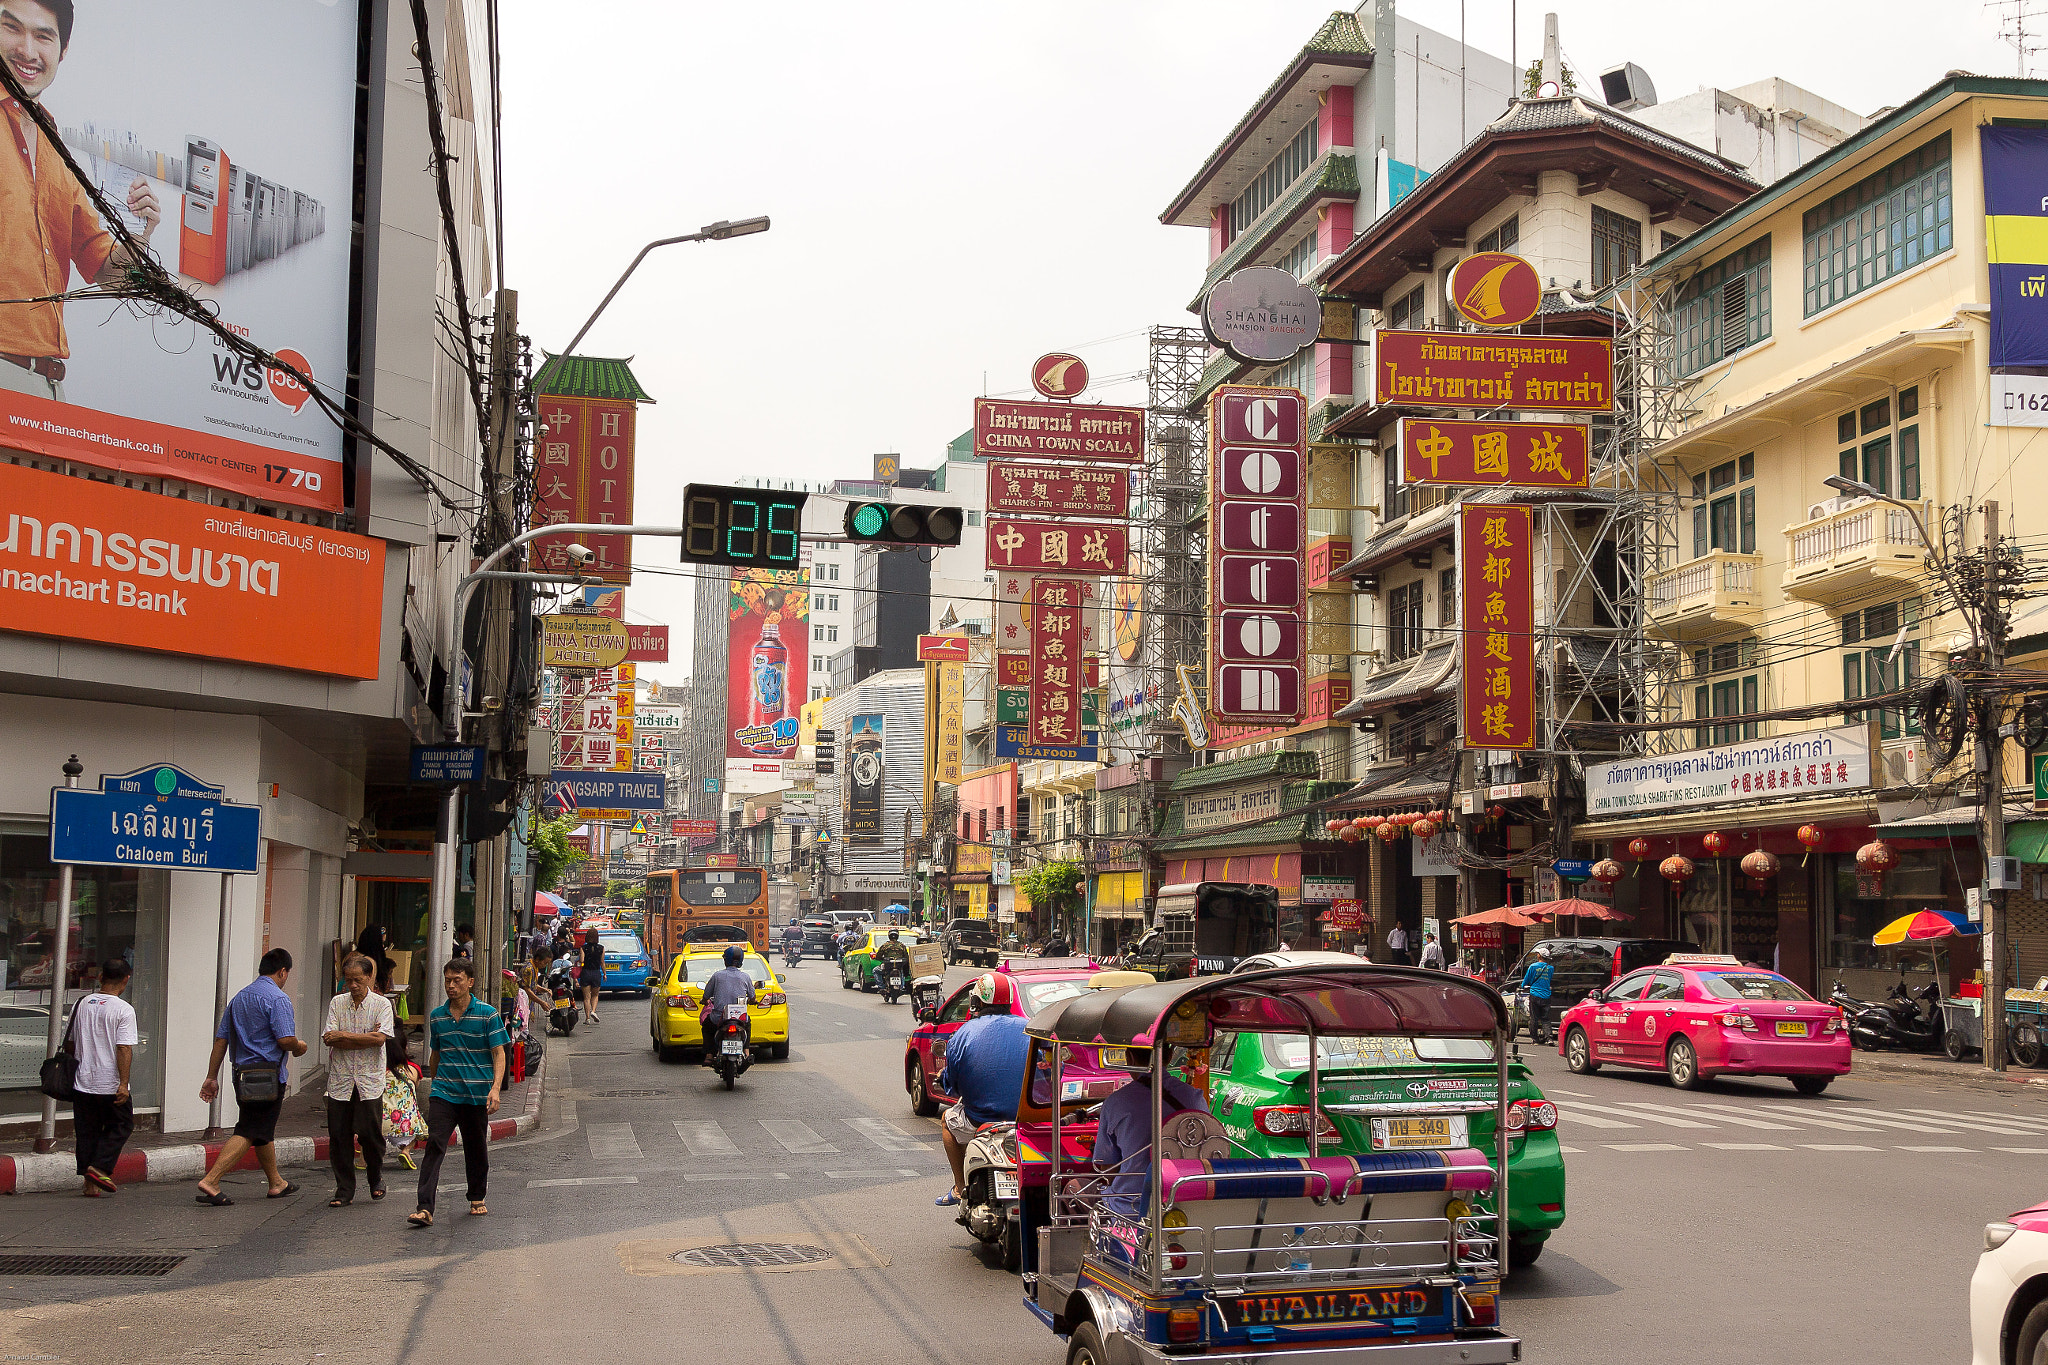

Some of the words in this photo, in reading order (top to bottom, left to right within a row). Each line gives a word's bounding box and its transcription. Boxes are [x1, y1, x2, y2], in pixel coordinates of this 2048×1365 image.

[1226, 311, 1306, 325] SHANGHAI
[1226, 323, 1265, 332] MANSION
[1270, 325, 1306, 334] BANGKOK
[1421, 337, 1568, 368] ภัตตาคารหูฉลาม
[1386, 361, 1513, 400] ไชน่าทาวน์
[1526, 371, 1603, 402] สกาล่า
[987, 405, 1073, 433] ไชน่าทาวน์
[1080, 414, 1132, 436] สกาล่า
[9, 413, 164, 455] www.thanachartbank.co.th
[986, 434, 1033, 449] CHINA
[1037, 436, 1082, 451] TOWN
[1085, 439, 1134, 454] SCALA
[1415, 425, 1572, 481] 中國城
[174, 448, 218, 466] CONTACT
[221, 458, 258, 475] CENTER
[263, 463, 322, 492] 1770
[598, 412, 621, 570] HOTEL
[999, 498, 1037, 508] SHARK'S
[1038, 500, 1054, 508] FIN
[1063, 501, 1092, 510] BIRD'S
[1094, 503, 1116, 512] NEST
[727, 500, 797, 560] 25
[204, 517, 314, 553] สาขาสี่แยกเฉลิมบุรี
[317, 538, 371, 565] (เยาวราช)
[996, 524, 1114, 570] 中國城
[0, 567, 110, 605] nachart
[117, 580, 188, 617] Bank
[631, 626, 665, 650] งเที่ยว
[1480, 516, 1514, 739] 銀都魚翅酒樓
[545, 632, 578, 648] HINA
[582, 634, 625, 650] TOWN
[554, 650, 600, 662] HOTEL
[1038, 587, 1073, 741] 銀都魚翅酒樓
[773, 718, 798, 739] 10
[1017, 747, 1078, 758] SEAFOOD
[420, 769, 444, 779] CHINA
[450, 769, 473, 779] TOWN
[120, 780, 141, 793] แยก
[178, 787, 221, 801] Intersection
[543, 781, 614, 798] RONGSARP
[618, 783, 661, 799] TRAVEL
[1611, 795, 1627, 808] TOWN
[1628, 792, 1648, 805] SCALA
[1648, 787, 1683, 804] SHARK-FINS
[1684, 783, 1728, 800] RESTAURANT
[111, 804, 215, 850] เฉลิมบุรี
[115, 844, 174, 863] Chaloem
[182, 849, 208, 865] Buri
[717, 873, 722, 883] 1
[443, 922, 448, 931] 3
[1198, 959, 1225, 971] PIANO
[1789, 1021, 1805, 1031] 2183
[1418, 1119, 1444, 1135] 349
[1236, 1290, 1429, 1323] THAILAND
